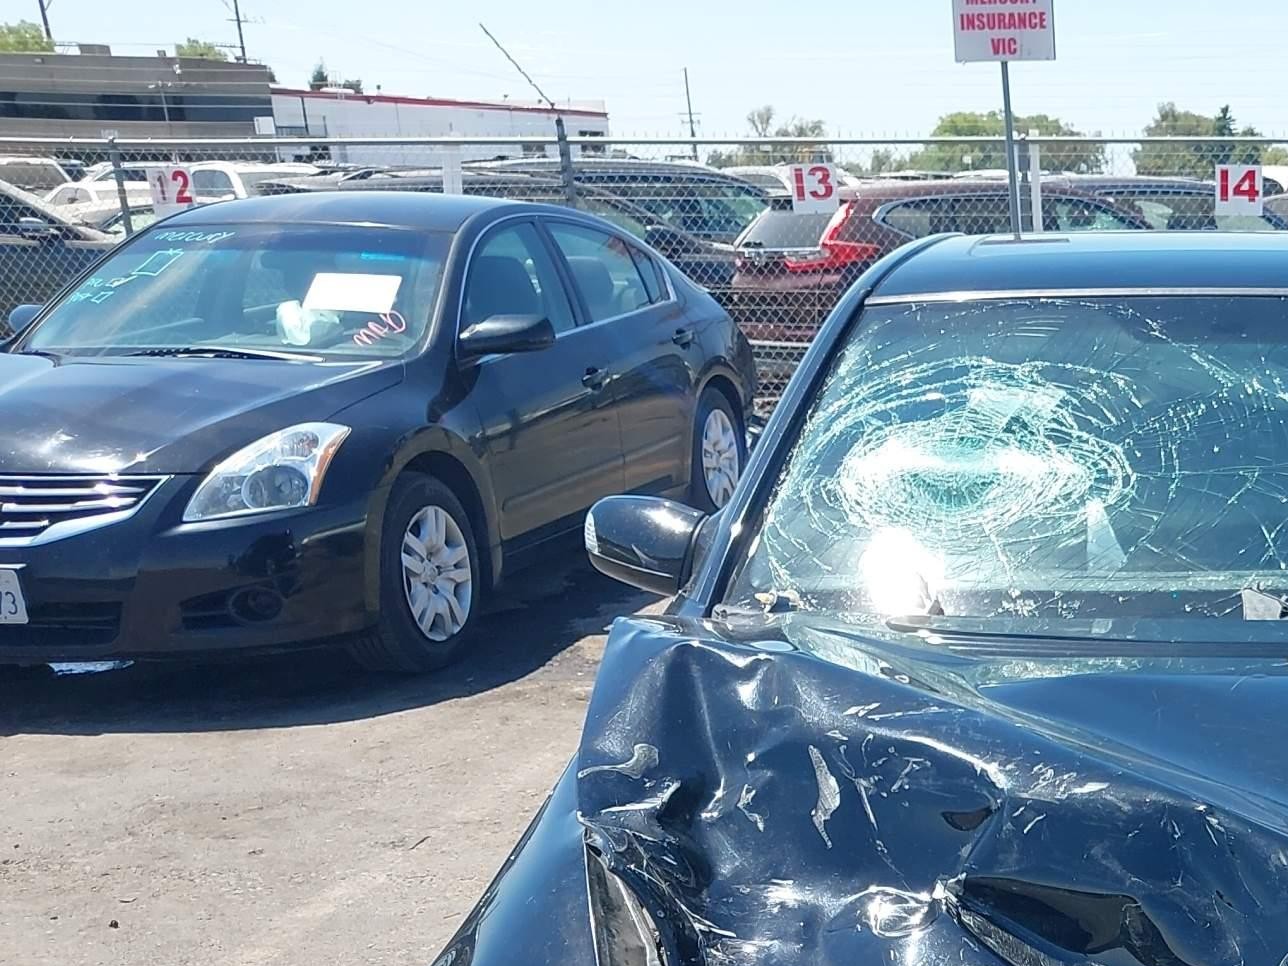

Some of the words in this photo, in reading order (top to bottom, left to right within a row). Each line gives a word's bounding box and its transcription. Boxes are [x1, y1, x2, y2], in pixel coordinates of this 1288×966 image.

[960, 12, 1046, 31] INSURANCE
[991, 37, 1017, 55] VIC
[794, 166, 833, 201] 13
[1220, 168, 1259, 202] 14
